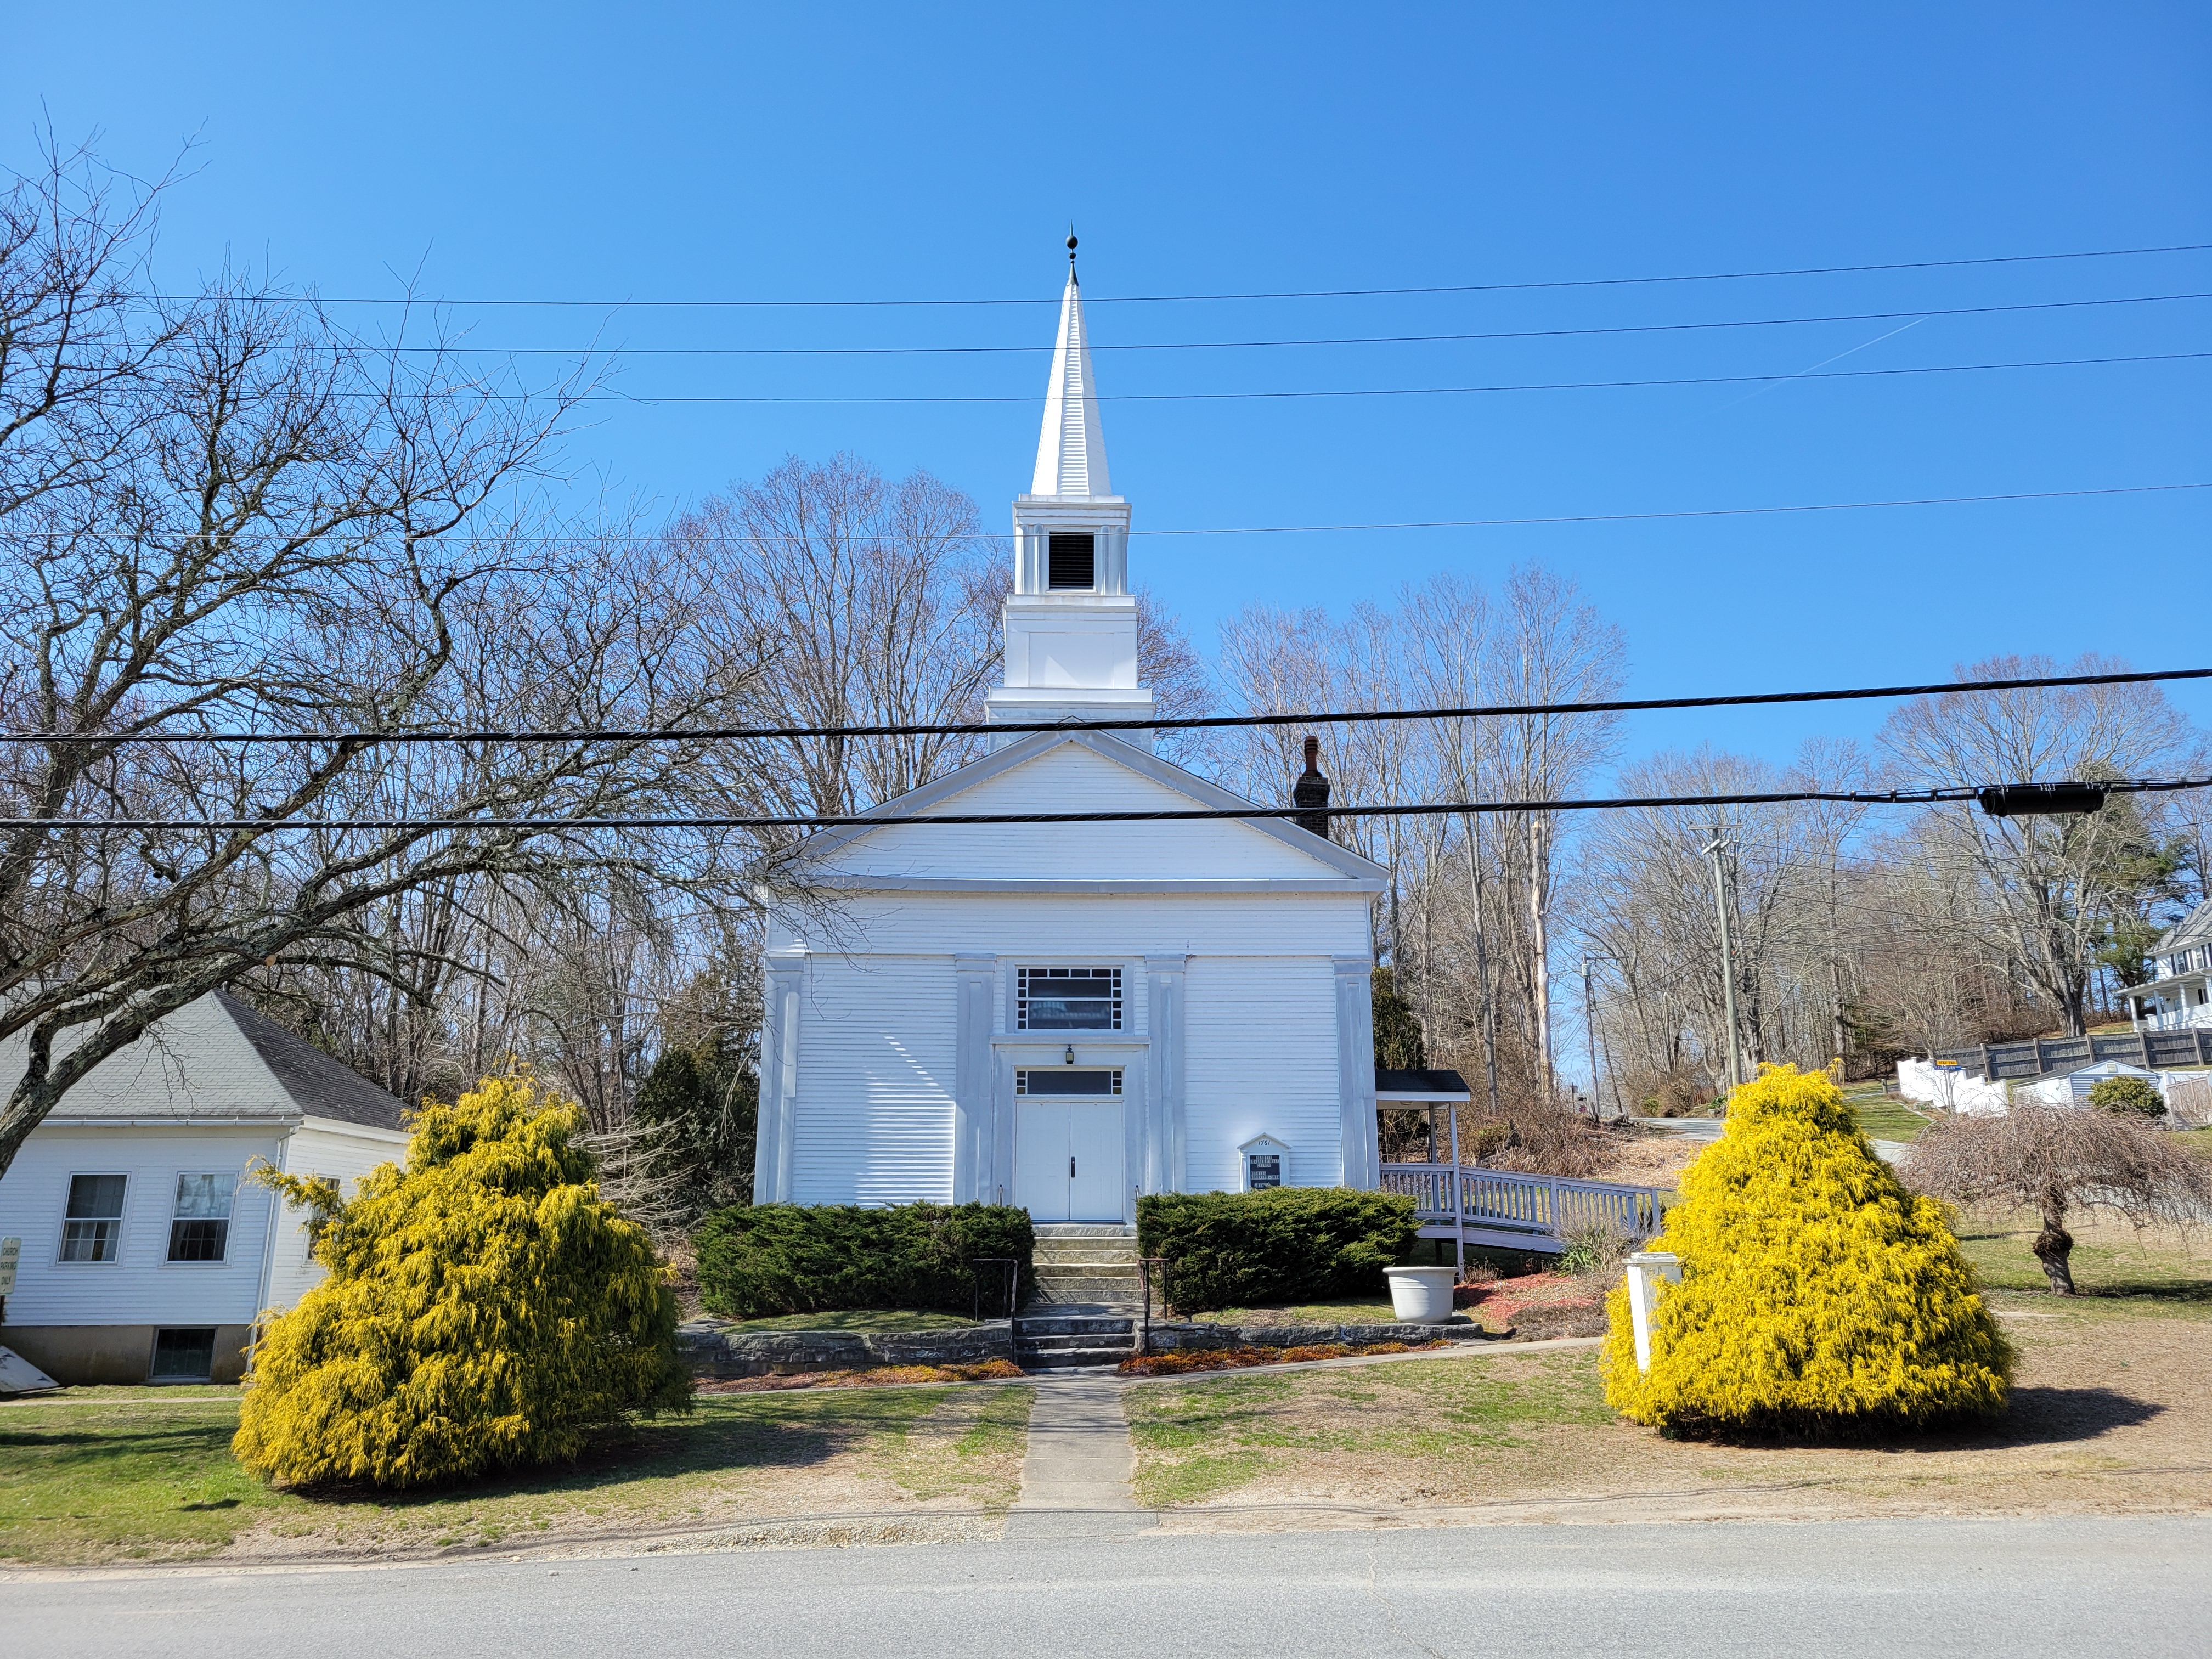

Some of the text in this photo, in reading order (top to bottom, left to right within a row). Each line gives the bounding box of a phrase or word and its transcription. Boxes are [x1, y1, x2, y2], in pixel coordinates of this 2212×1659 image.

[3, 1247, 18, 1256] CHURCH
[0, 1262, 16, 1270] PARKING
[1, 1276, 12, 1285] ONLY
